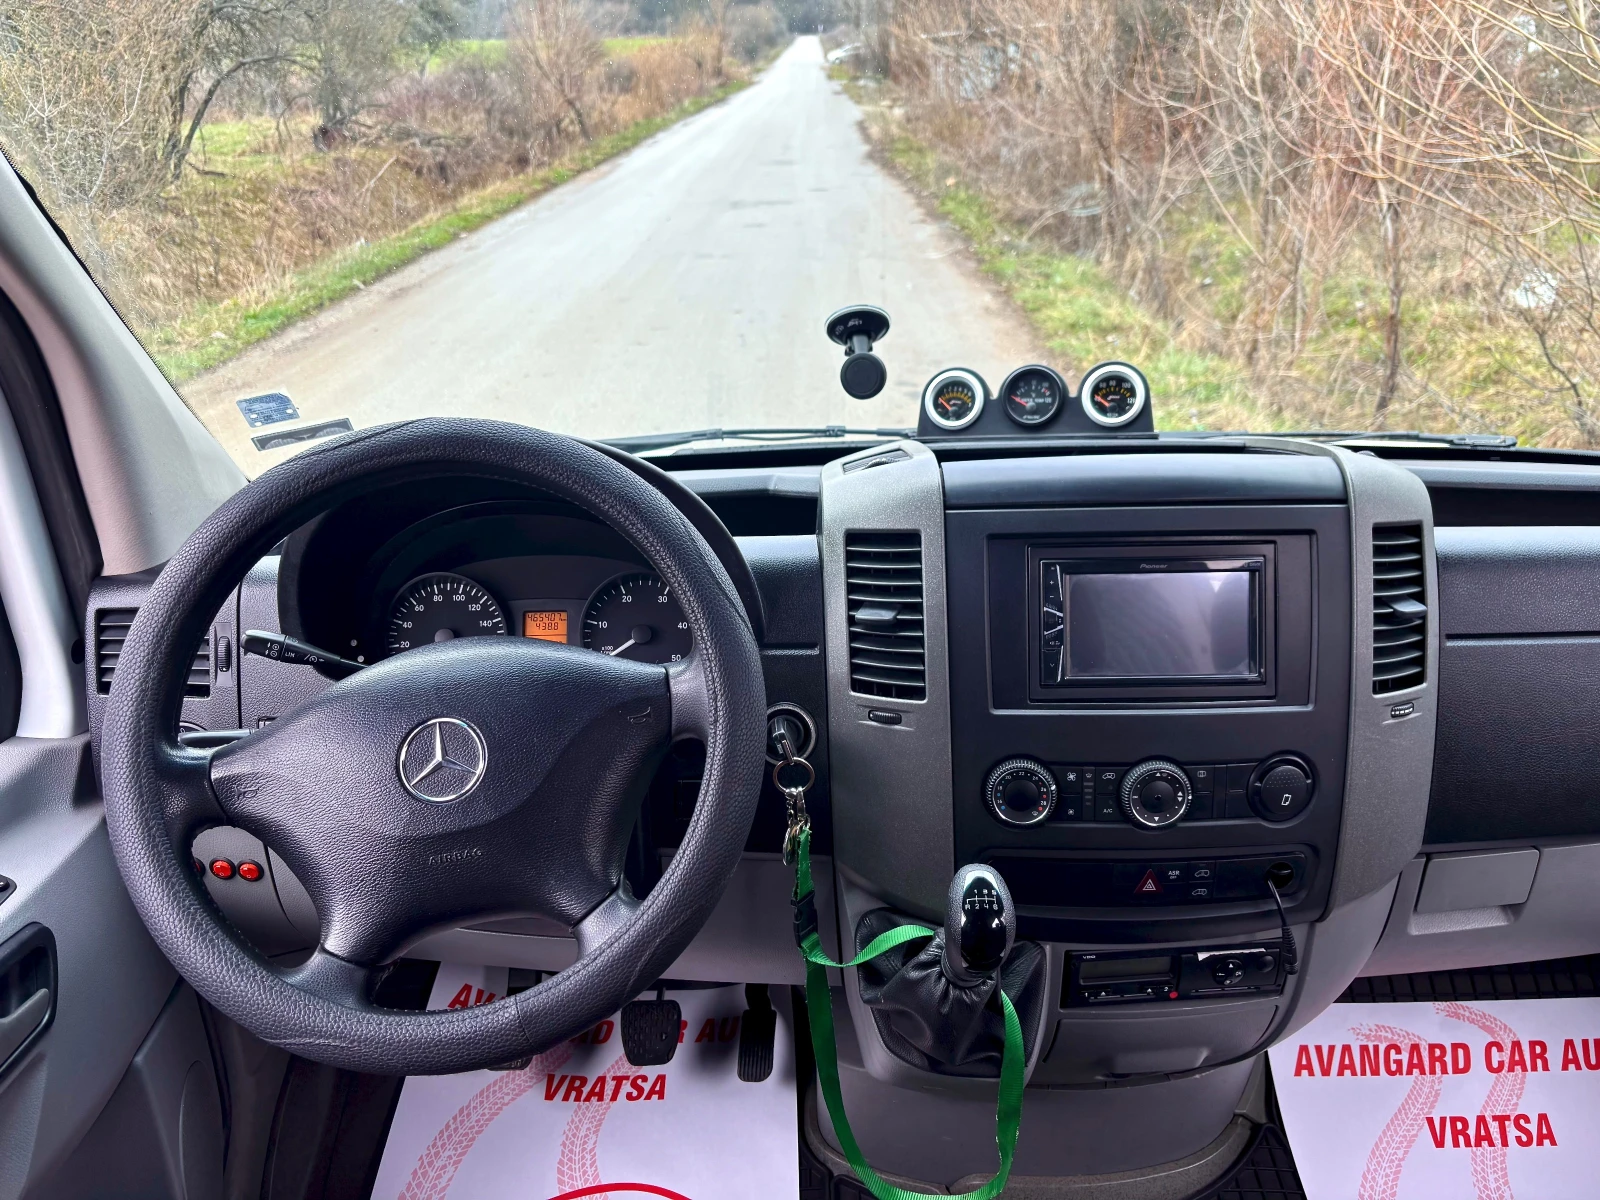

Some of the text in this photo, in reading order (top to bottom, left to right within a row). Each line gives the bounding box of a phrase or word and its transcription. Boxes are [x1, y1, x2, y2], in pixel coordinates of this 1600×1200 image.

[528, 613, 562, 621] 465407
[1294, 1042, 1472, 1077] AVANGARD
[1484, 1040, 1550, 1074] CAR
[544, 1074, 666, 1102] VRATSA
[1426, 1112, 1558, 1149] VRATSA
